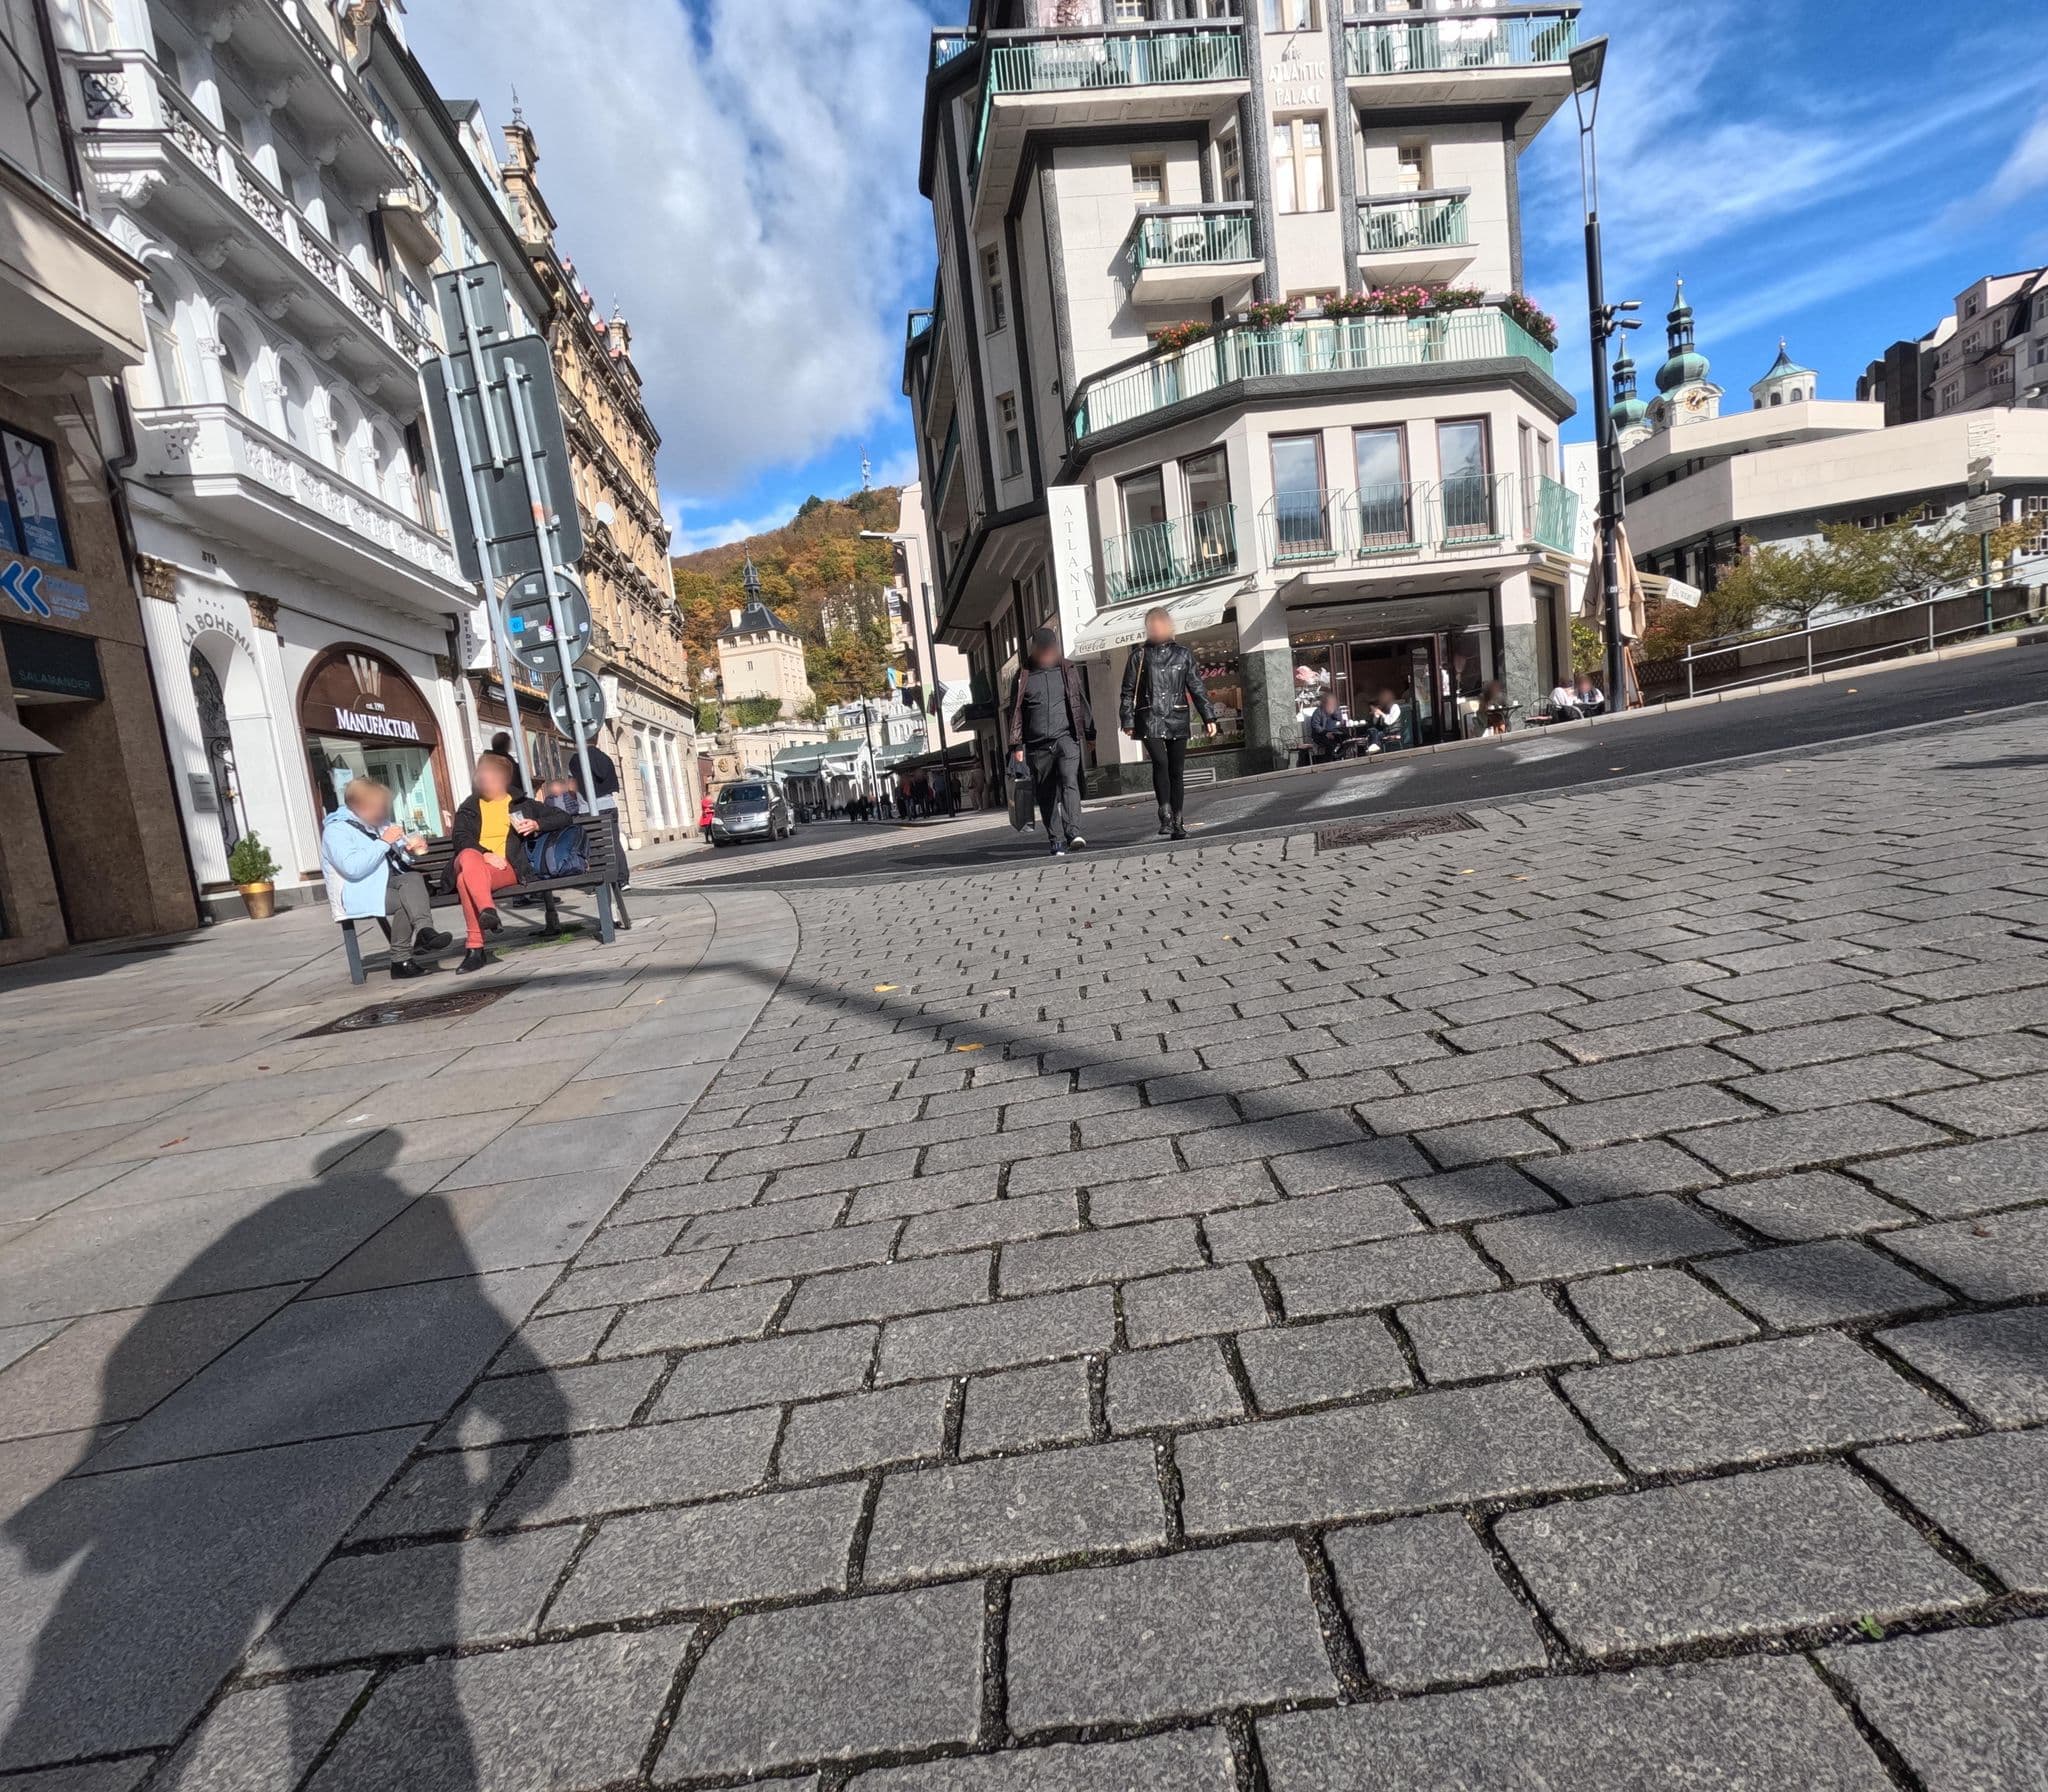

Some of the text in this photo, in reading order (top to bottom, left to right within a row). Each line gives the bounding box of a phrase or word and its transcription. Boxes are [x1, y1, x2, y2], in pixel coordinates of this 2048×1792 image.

[1267, 61, 1325, 83] ATLANTIC
[1274, 85, 1321, 106] PALACE
[1577, 460, 1590, 585] ATLANT
[1063, 504, 1082, 635] ATLANTIC
[194, 612, 257, 665] BOHEMIA
[335, 707, 420, 741] MANUFAKTURA
